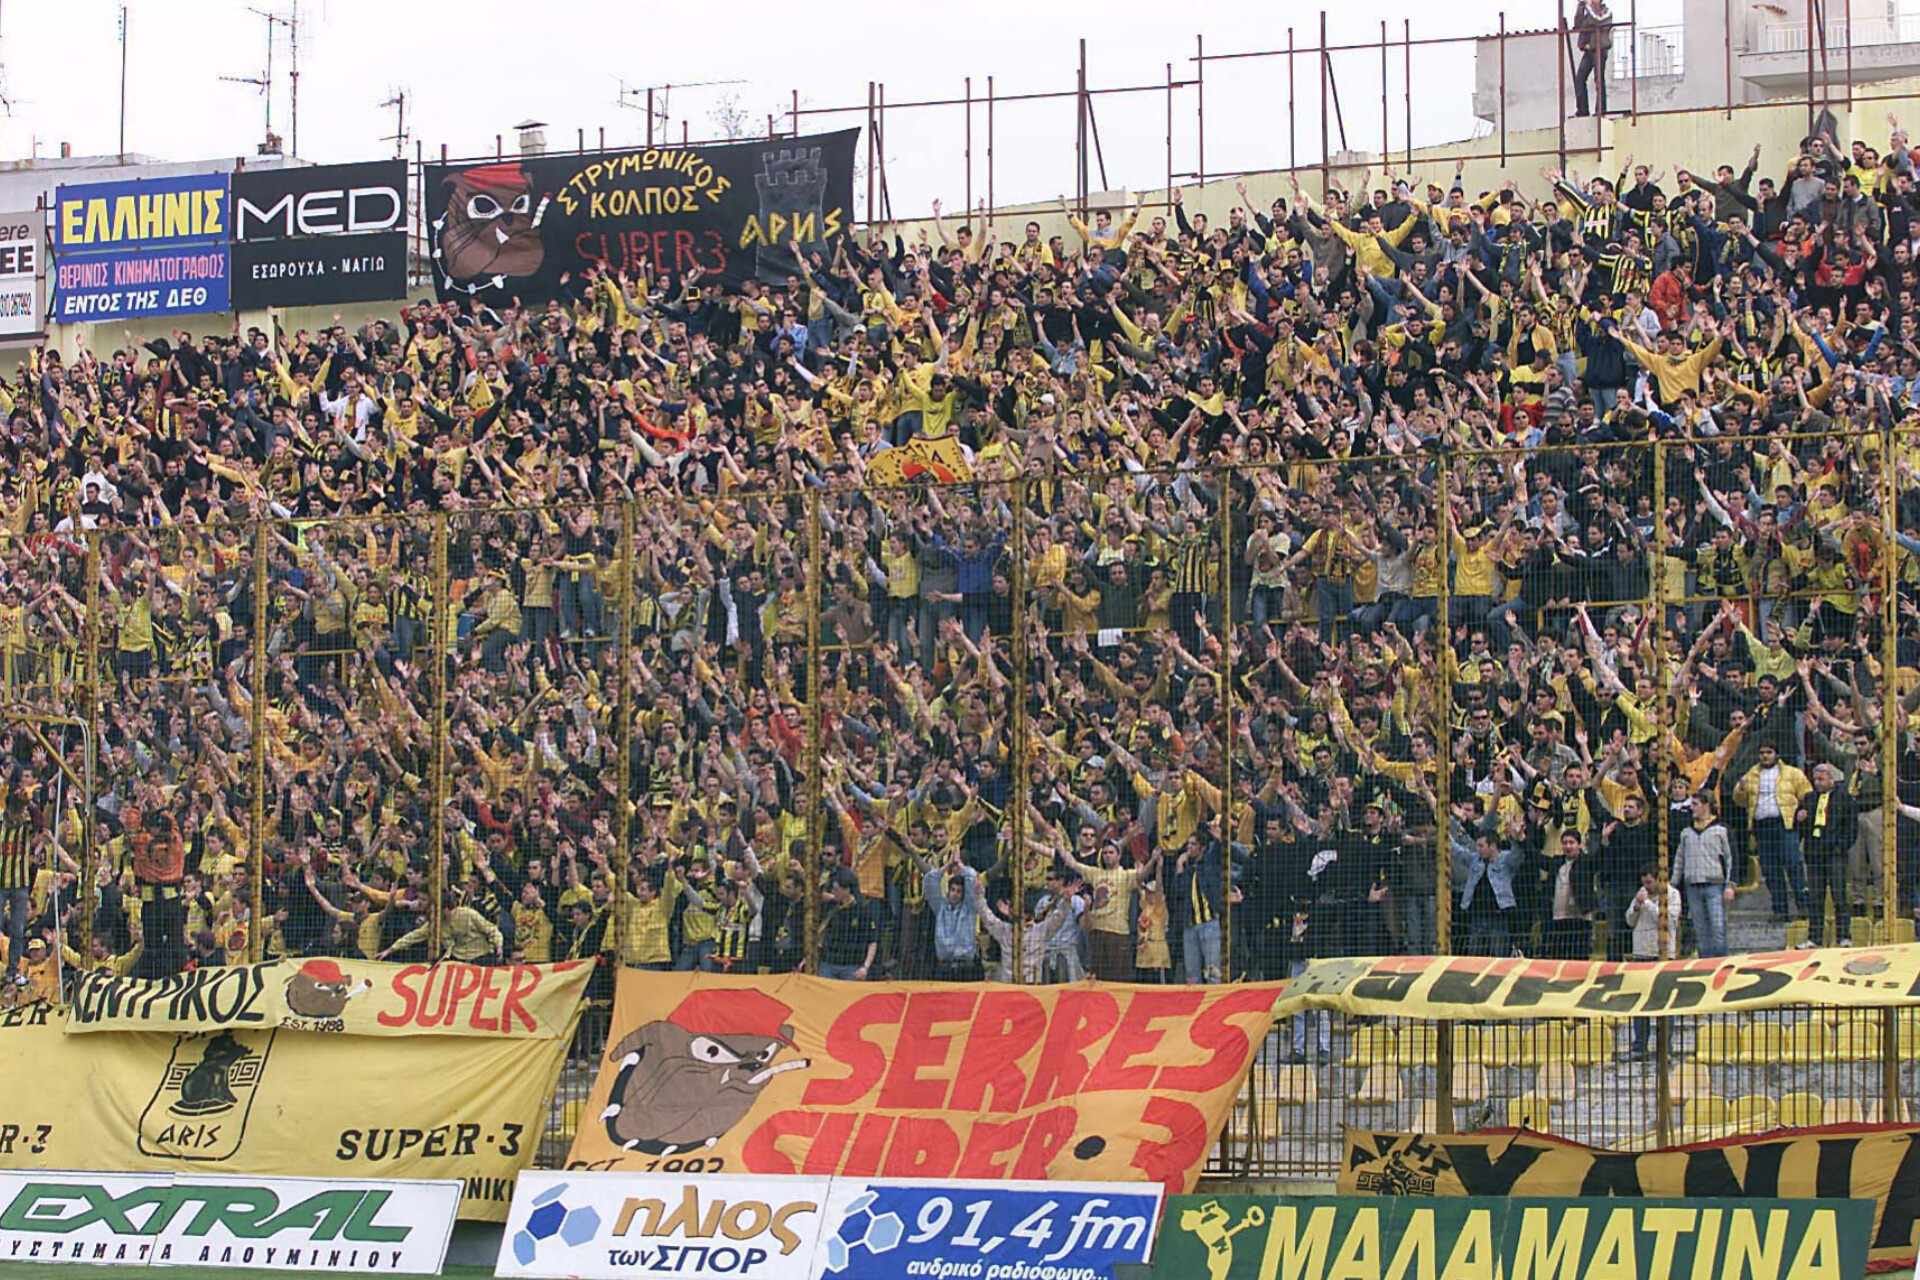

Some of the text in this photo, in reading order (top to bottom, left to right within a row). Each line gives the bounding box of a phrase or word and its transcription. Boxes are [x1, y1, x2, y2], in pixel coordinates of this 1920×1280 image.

[556, 150, 732, 216] ΣΤΡΥΜΩΝΙΚΟΣ
[62, 190, 224, 245] ΕΛΛΗΝΙΣ
[590, 185, 699, 219] ΚΟΛΠΟΣ
[59, 254, 225, 290] ΘΕΡΙΝΟΣ ΚΙΝΗΜΑΤΟΓΡΑΦΟΣ
[252, 260, 325, 280] ΕΣΩΡΟΥΧΑ
[342, 256, 385, 274] ΜΑΓΙΩ
[64, 287, 208, 315] ΕΝΤΟΣ ΤΗΣ ΔΕΘ
[377, 963, 543, 1034] SUPER
[800, 988, 1282, 1113] SERRES
[156, 1124, 221, 1148] ARIS
[0, 1182, 413, 1242] EXTRAL
[907, 1196, 1147, 1262] 91,4 fm
[199, 1245, 402, 1269] ΑΛΟΥΜΙΝΙΟΥ
[906, 1257, 984, 1280] ανδρικό
